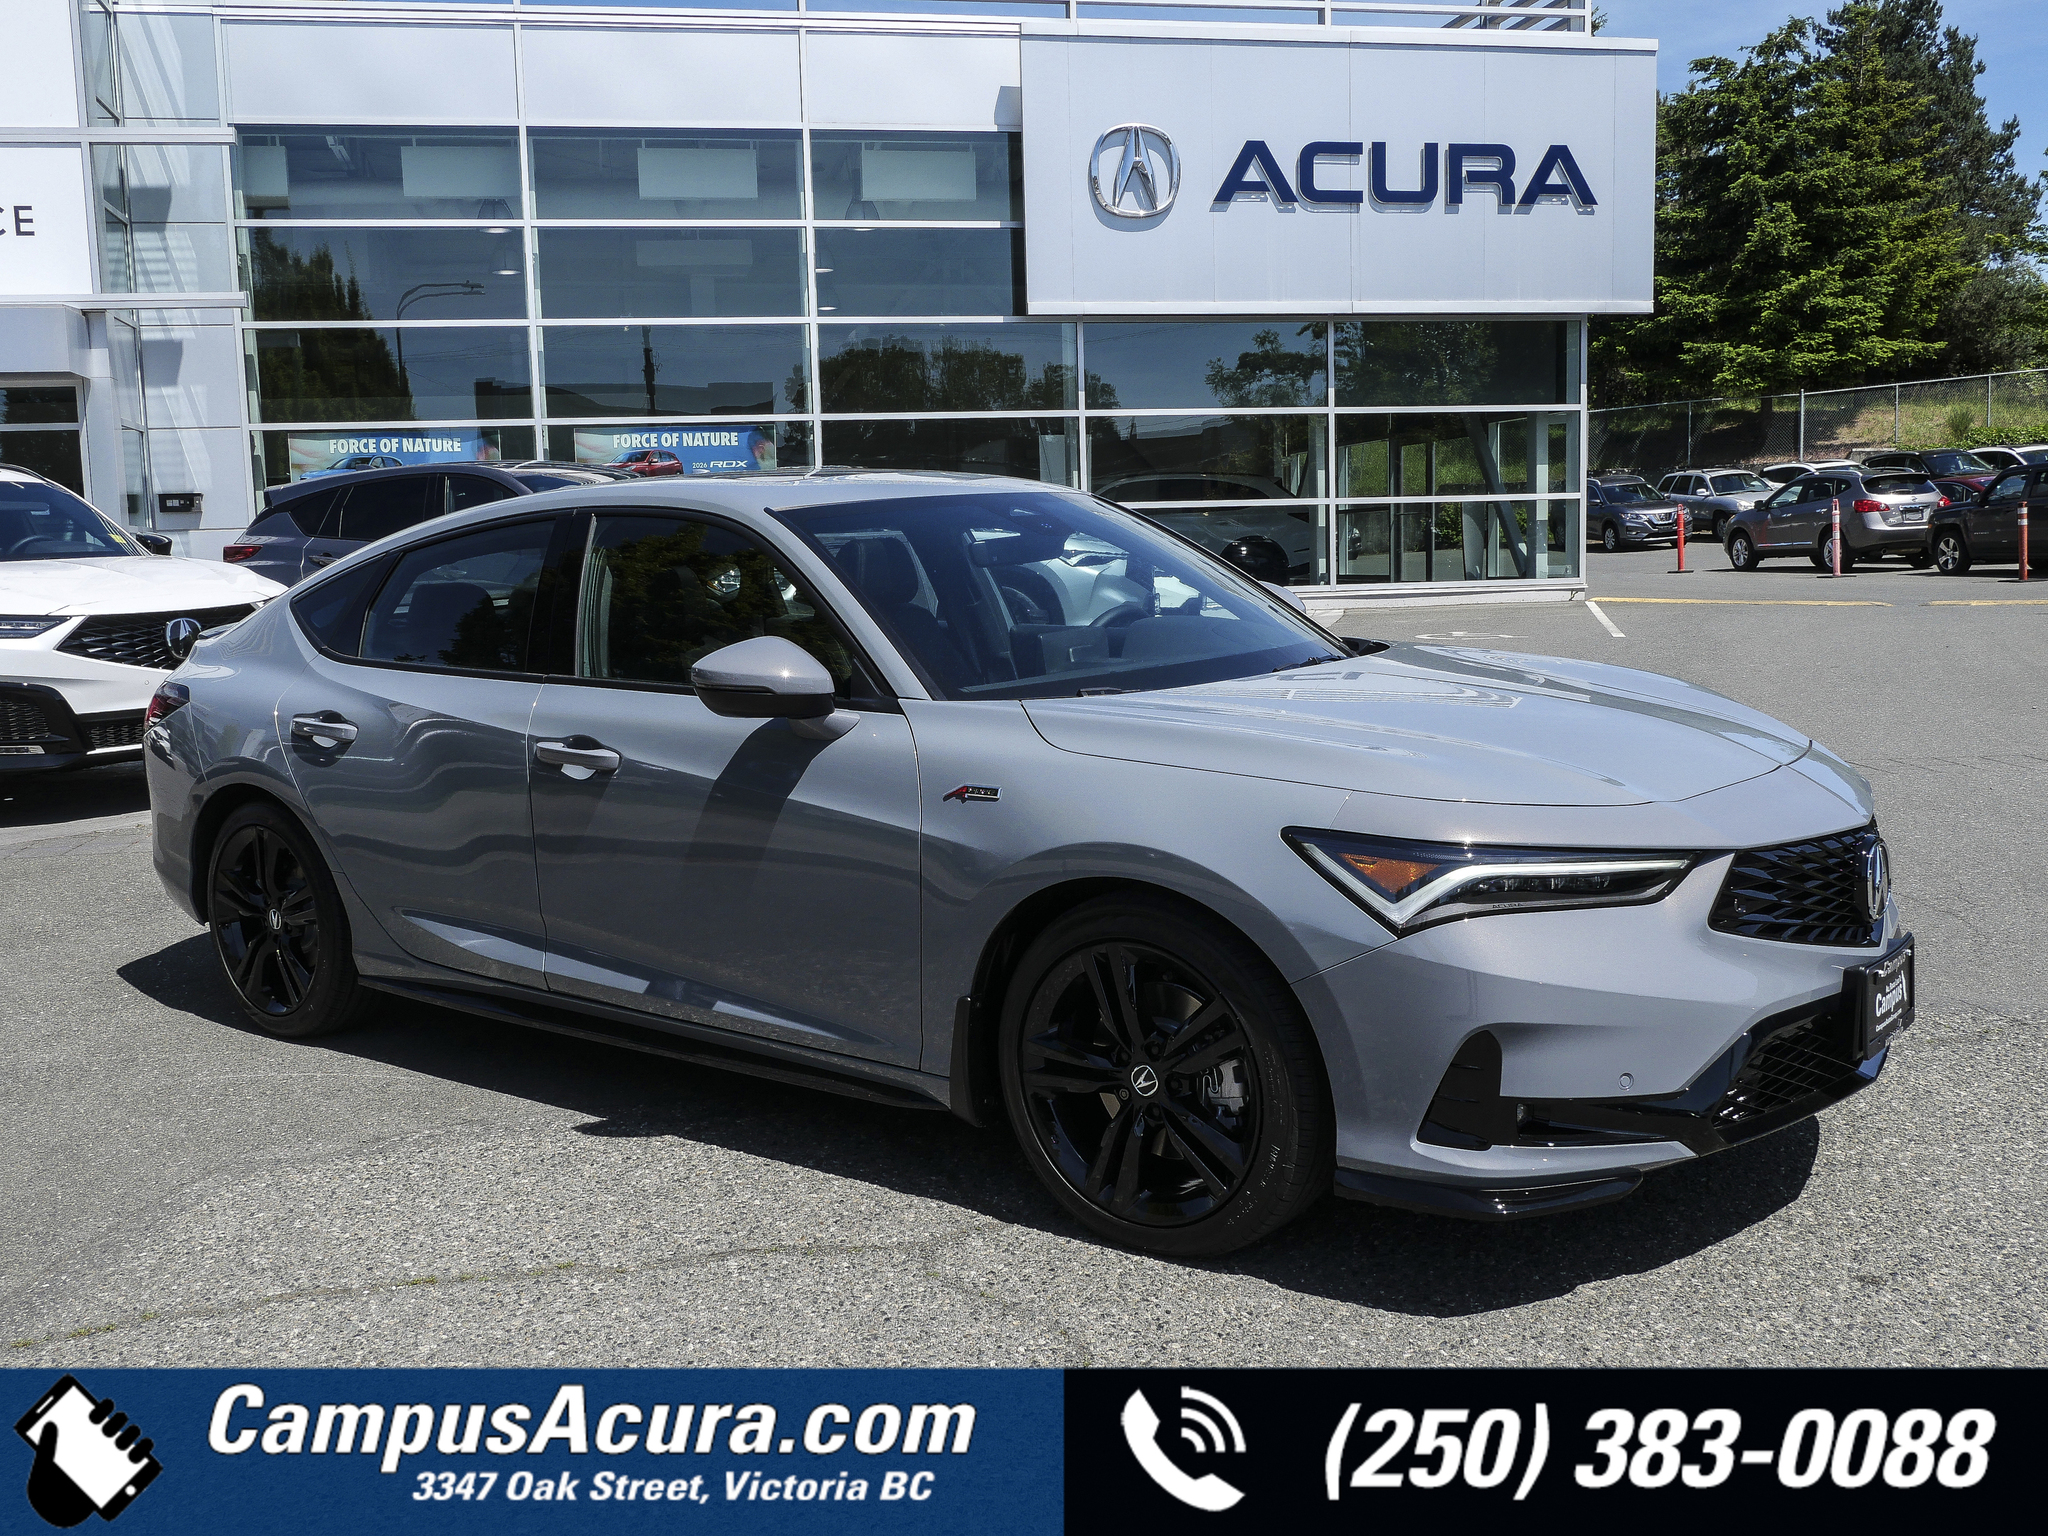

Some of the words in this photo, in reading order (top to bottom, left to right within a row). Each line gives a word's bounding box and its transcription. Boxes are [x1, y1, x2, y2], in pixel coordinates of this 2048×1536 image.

[1212, 140, 1598, 205] ACURA
[329, 439, 377, 454] FORCE
[379, 438, 400, 453] OF
[402, 438, 462, 453] NATURE
[612, 434, 658, 448] FORCE
[661, 433, 680, 448] OF
[683, 432, 739, 447] NATURE
[709, 460, 748, 468] RDX
[1876, 983, 1903, 1017] Campus
